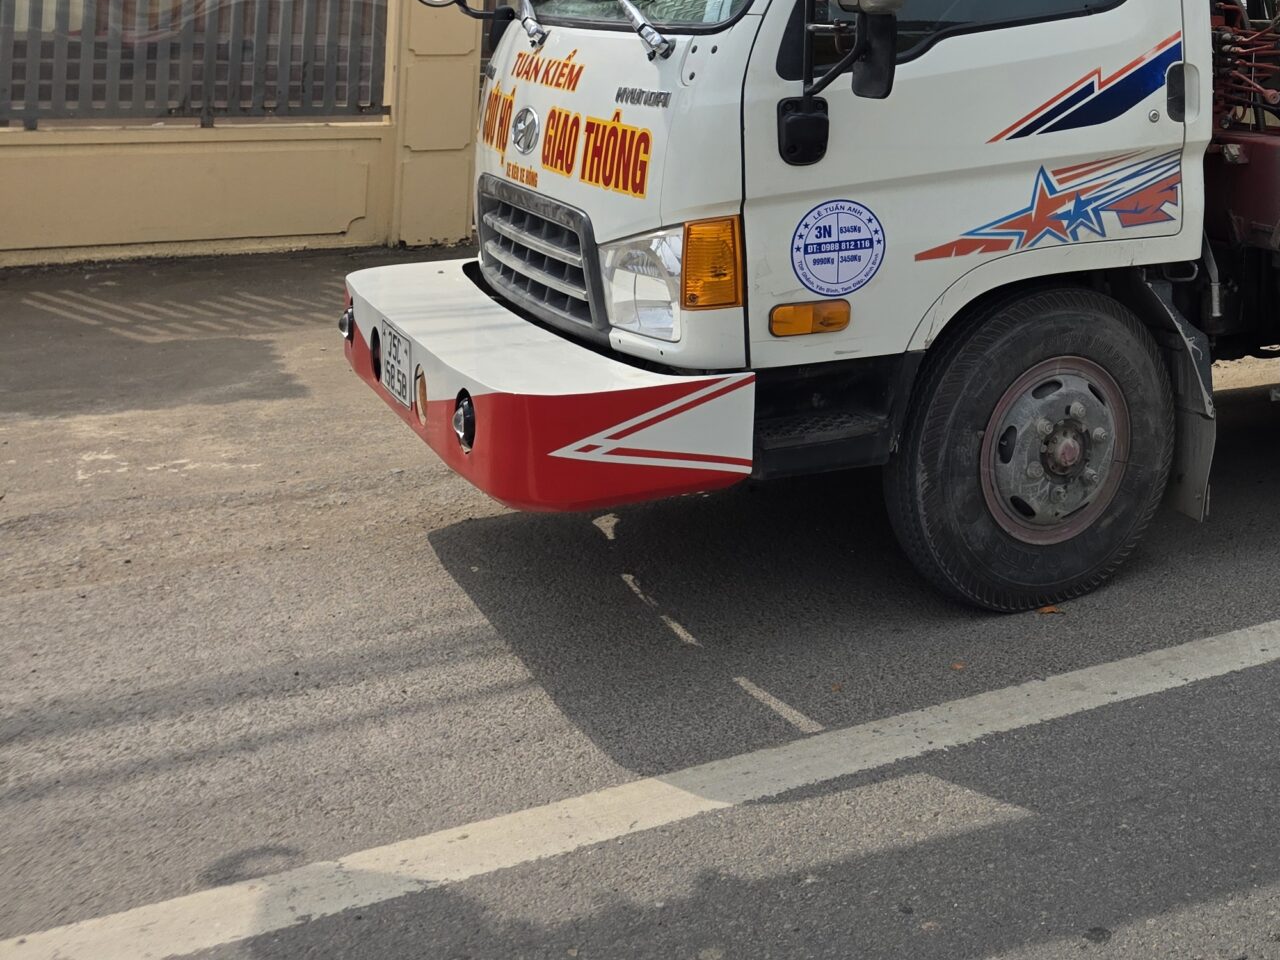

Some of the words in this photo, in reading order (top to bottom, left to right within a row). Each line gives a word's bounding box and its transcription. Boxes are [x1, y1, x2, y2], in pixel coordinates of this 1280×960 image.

[615, 86, 672, 109] HYUNDAI
[542, 106, 581, 178] GIAO
[579, 108, 653, 200] THÔNG
[847, 206, 863, 216] ANH
[815, 224, 832, 239] 3N
[821, 242, 839, 251] 0988
[841, 241, 855, 250] 812
